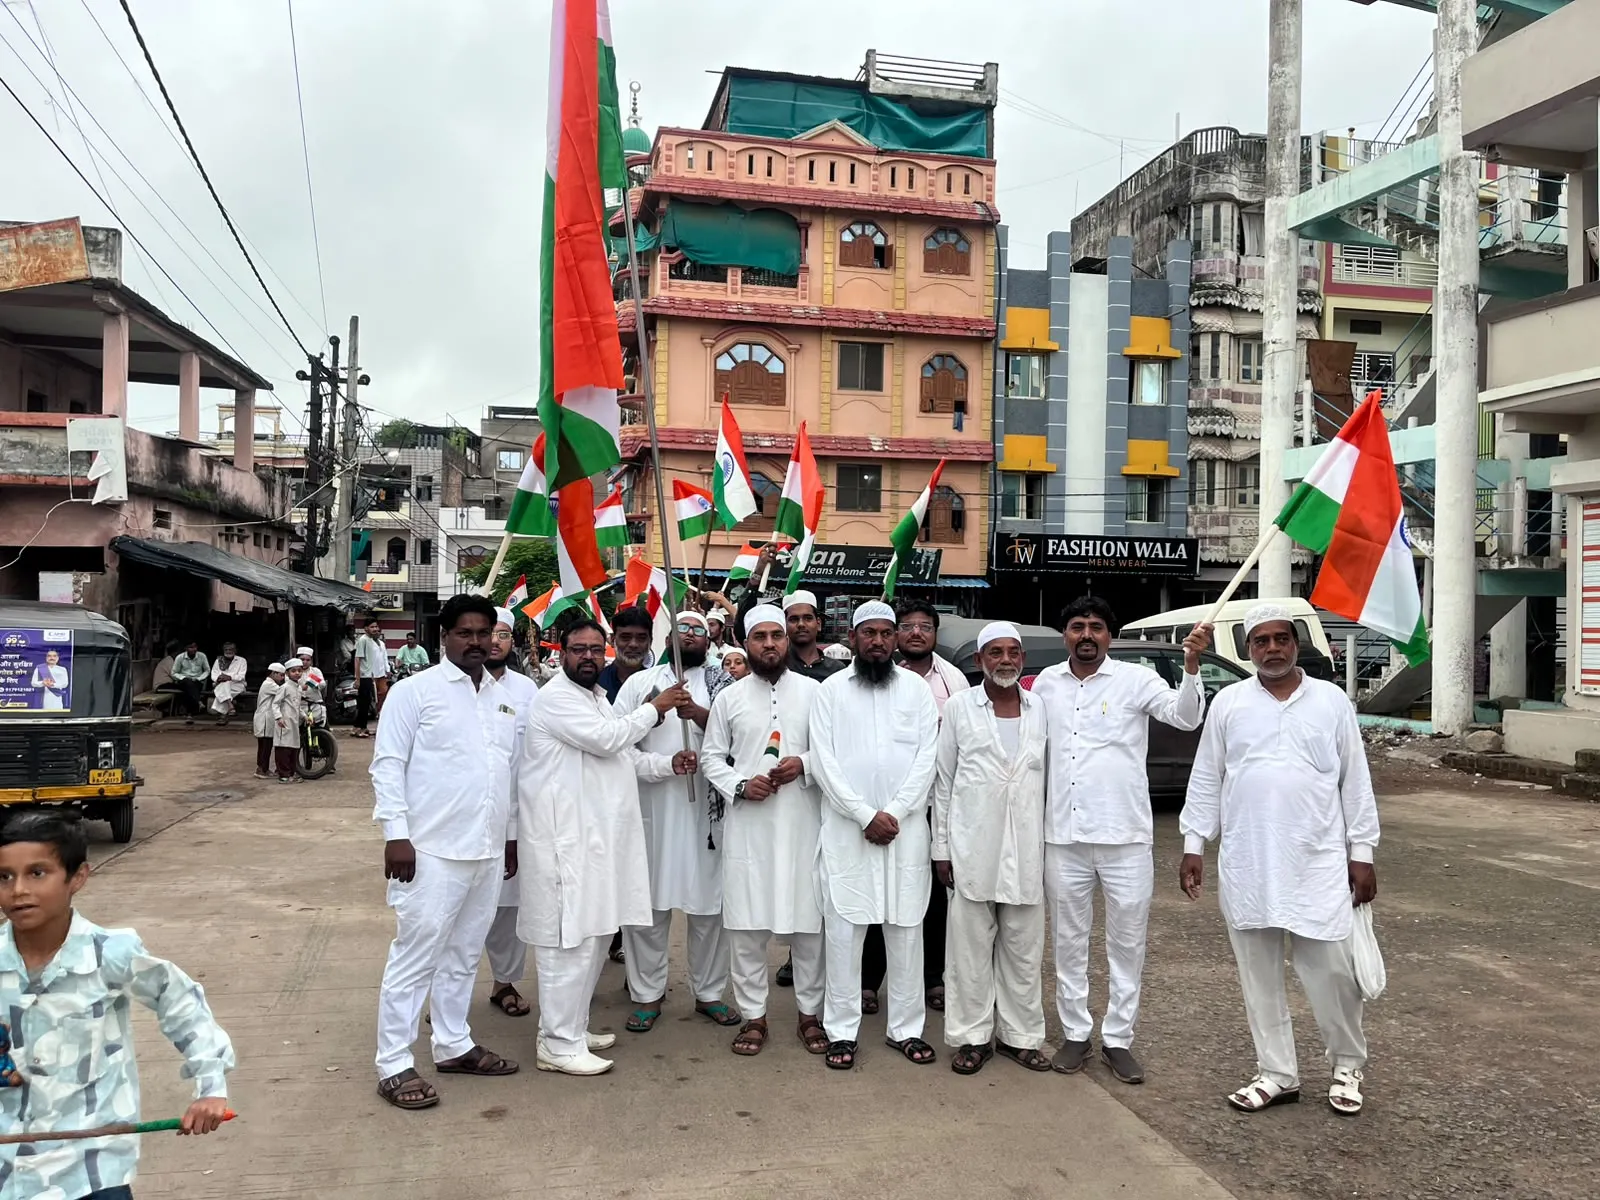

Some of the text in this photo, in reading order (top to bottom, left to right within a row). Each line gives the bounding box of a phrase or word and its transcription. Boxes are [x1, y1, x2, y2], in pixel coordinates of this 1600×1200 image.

[1047, 539, 1188, 559] FASHION WALA
[1088, 558, 1148, 568] MENS WEAR
[805, 566, 834, 575] Jeans
[835, 567, 866, 577] Home
